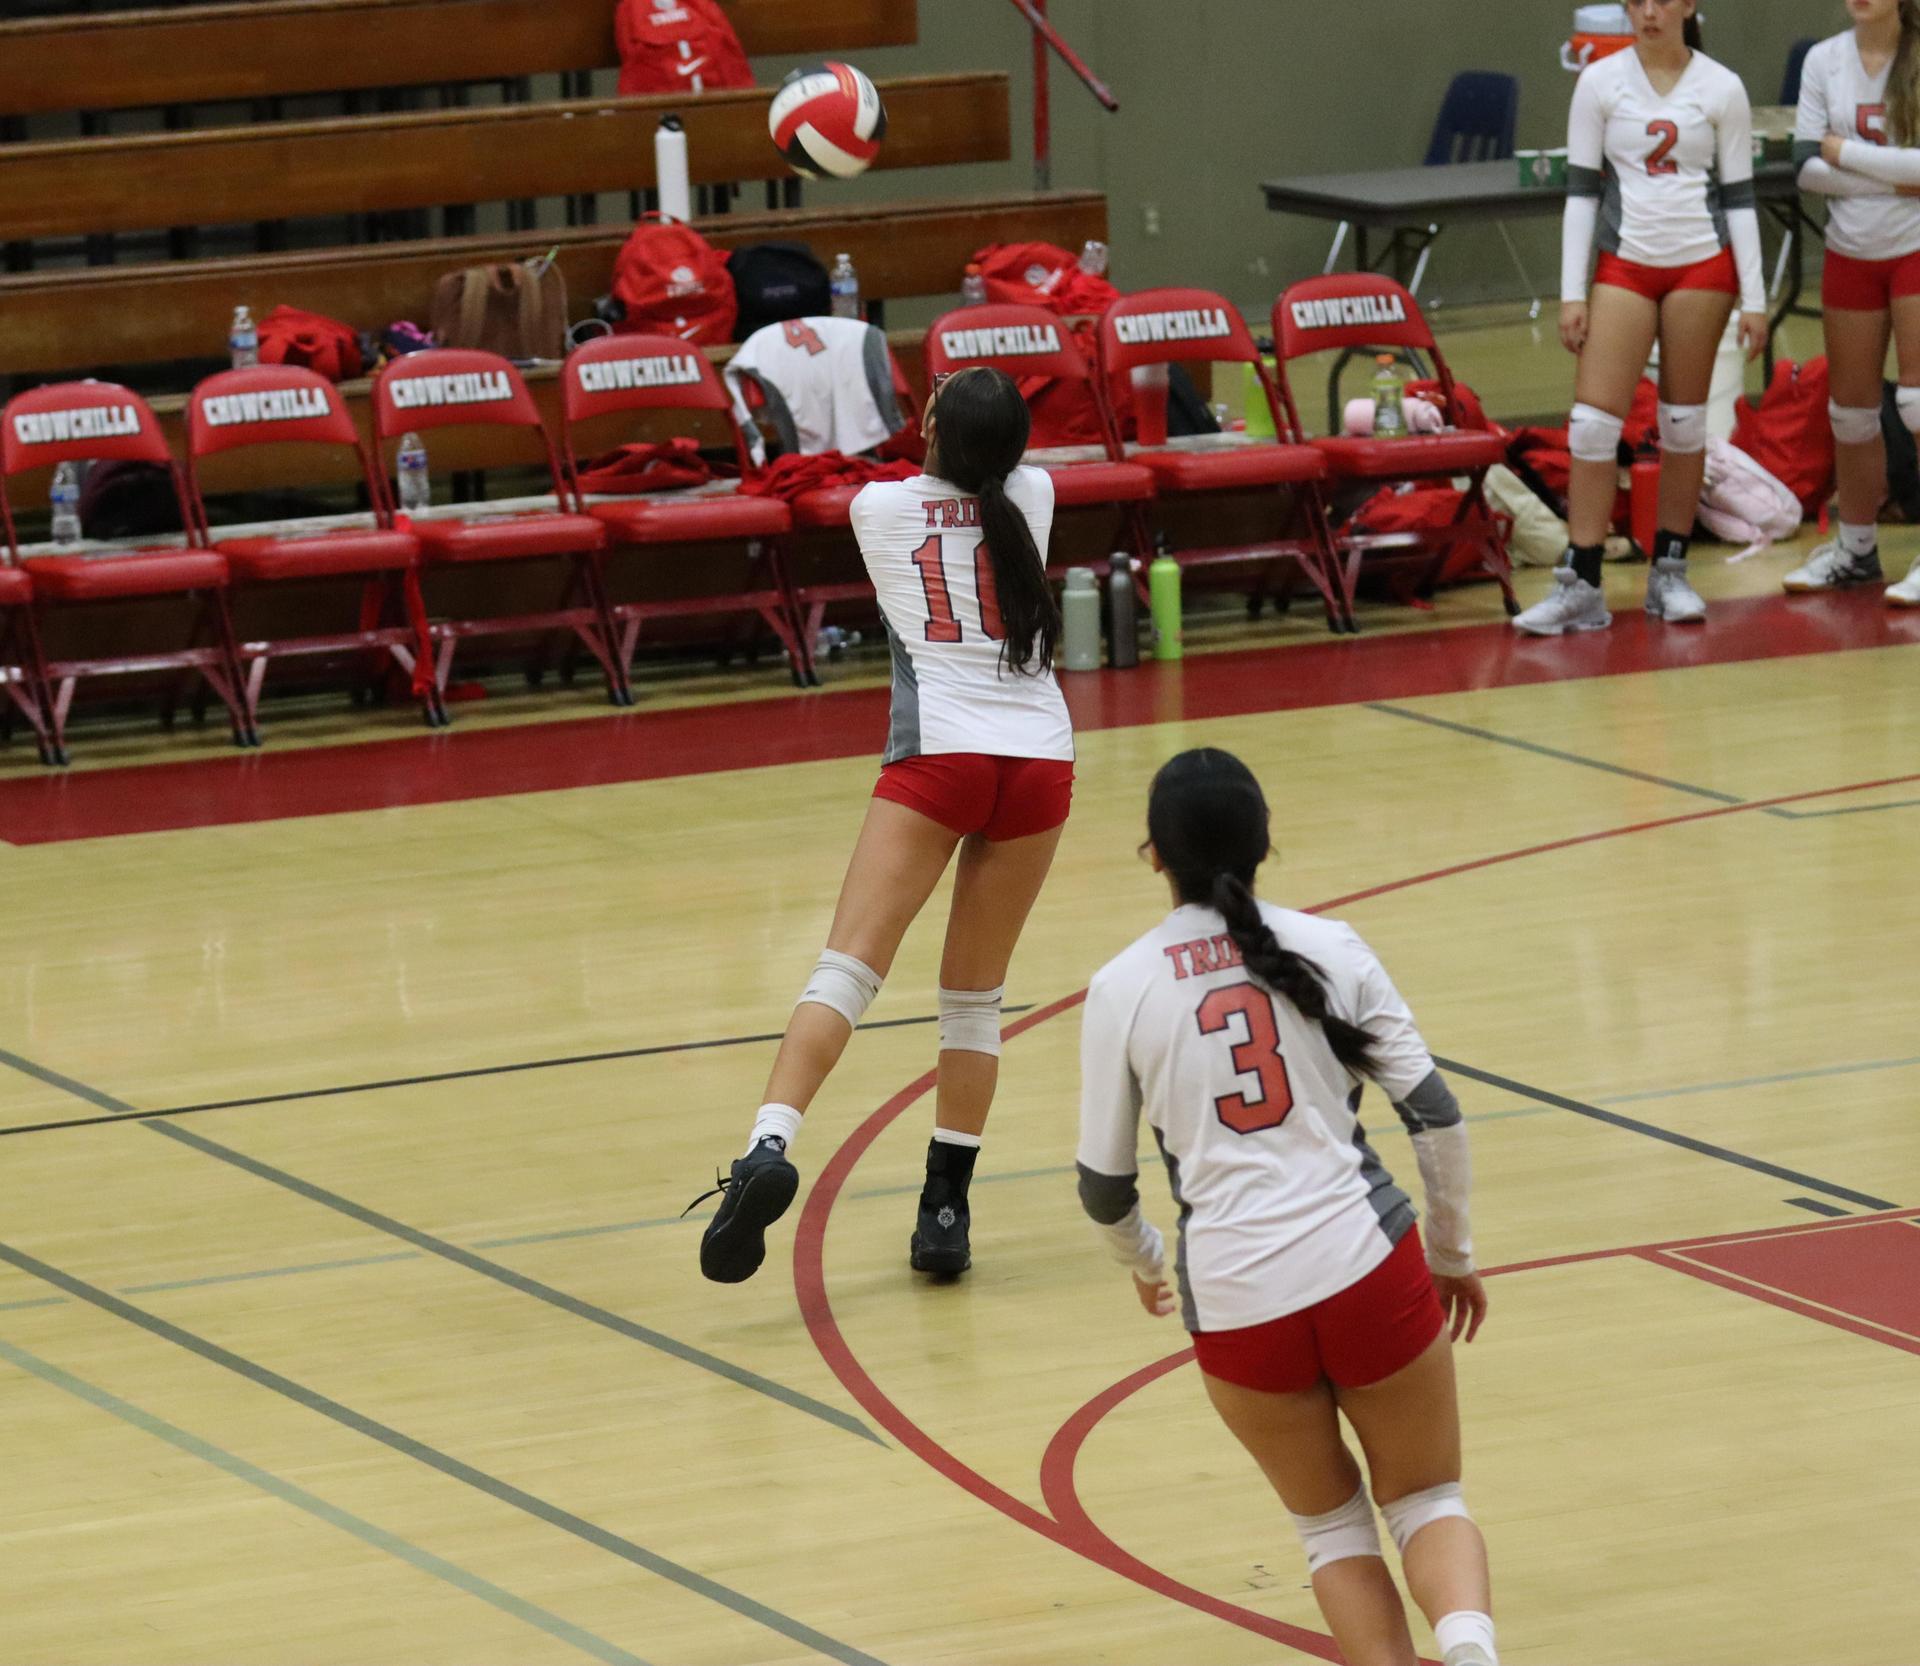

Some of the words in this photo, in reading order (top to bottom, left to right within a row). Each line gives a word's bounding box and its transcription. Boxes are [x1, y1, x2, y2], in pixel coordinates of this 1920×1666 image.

[1645, 118, 1679, 177] 2
[1113, 308, 1231, 345] CHOWCHILLA
[1290, 293, 1406, 330] CHOWCHILLA
[940, 323, 1062, 360] CHOWCHILLA
[389, 370, 513, 408] CHOWCHILLA
[577, 354, 703, 393] CHOWCHILLA
[13, 404, 142, 445] CHOWCHILLA
[202, 387, 331, 427] CHOWCHILLA
[1195, 981, 1295, 1136] 3
